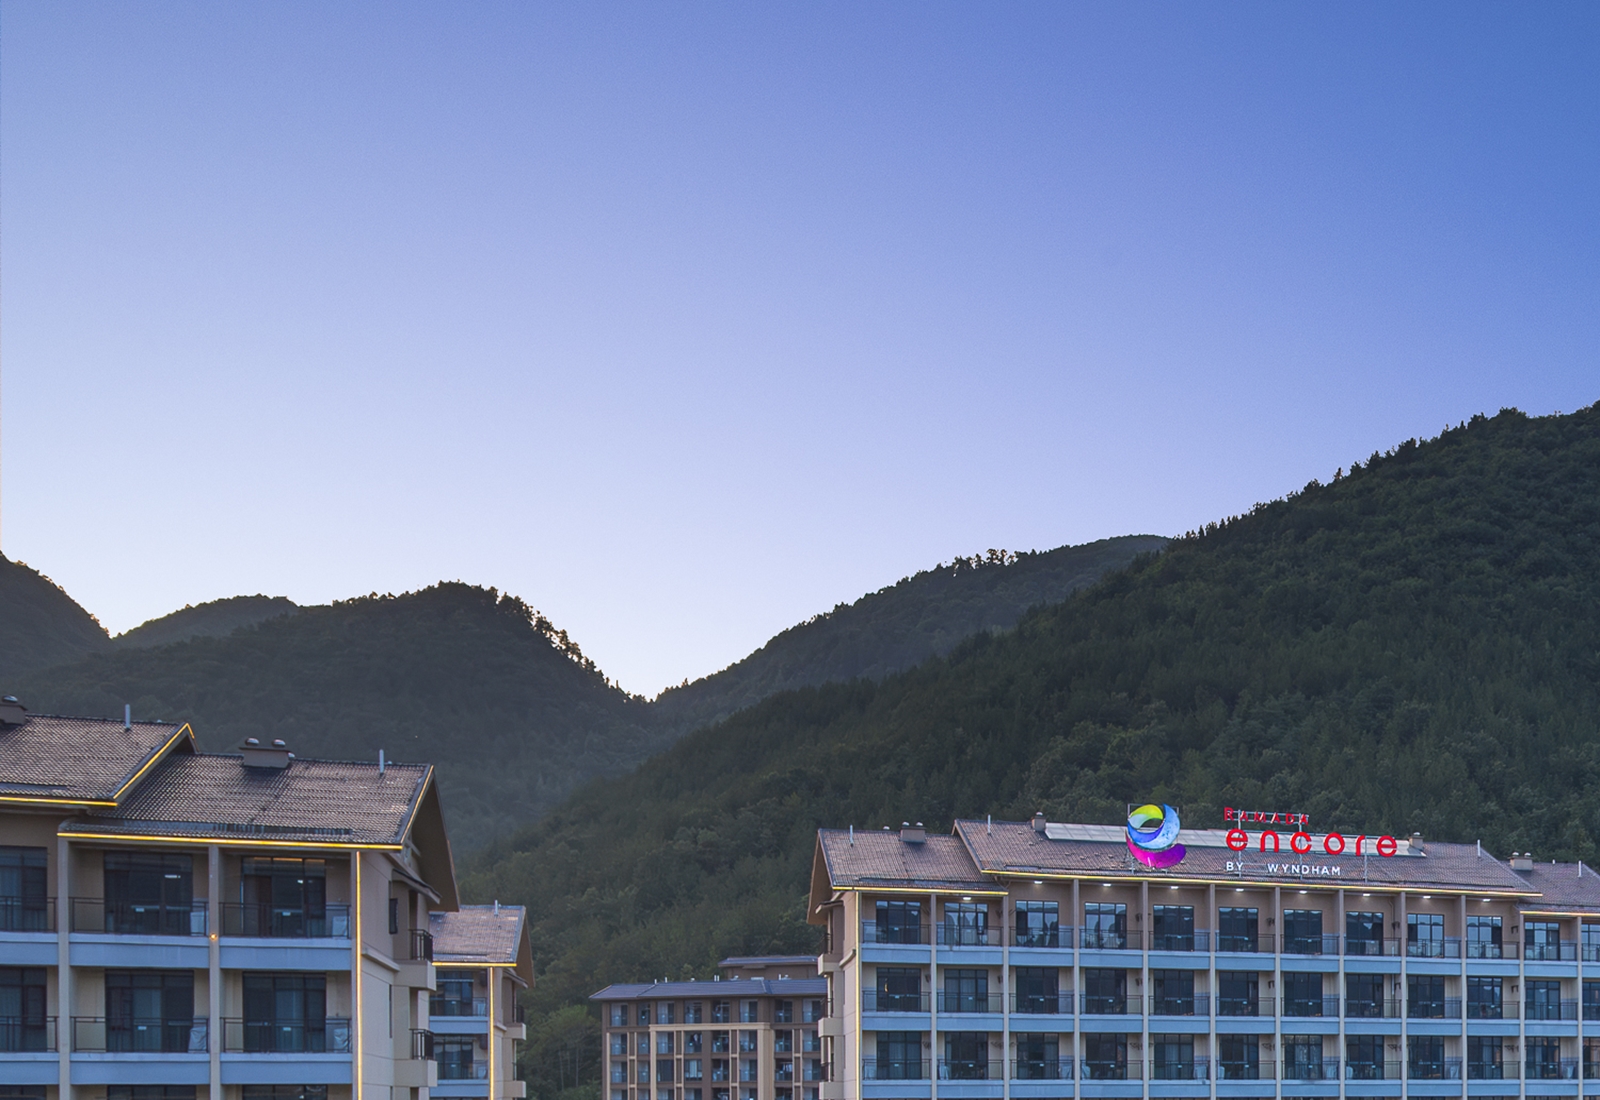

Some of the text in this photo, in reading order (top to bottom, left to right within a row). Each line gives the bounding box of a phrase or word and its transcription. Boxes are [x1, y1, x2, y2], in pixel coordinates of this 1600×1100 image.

[1223, 807, 1309, 826] RAMADA
[1225, 828, 1398, 858] encore
[1226, 861, 1341, 876] BY WYNDHAM
